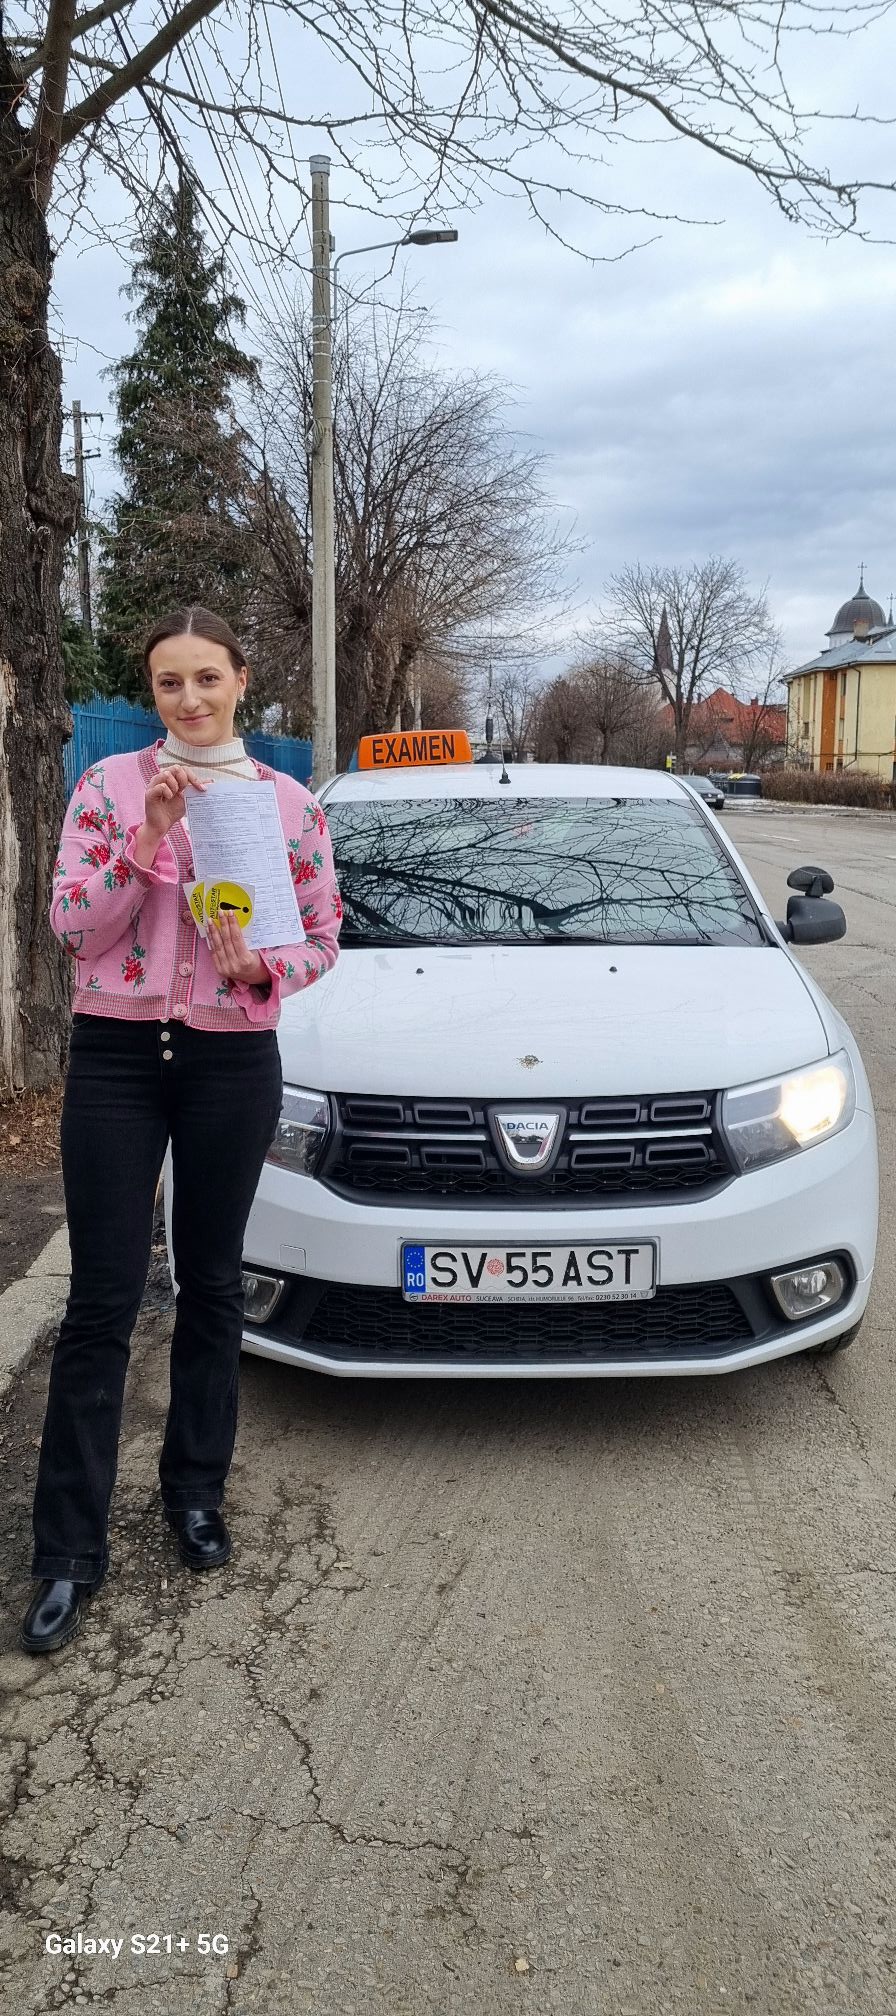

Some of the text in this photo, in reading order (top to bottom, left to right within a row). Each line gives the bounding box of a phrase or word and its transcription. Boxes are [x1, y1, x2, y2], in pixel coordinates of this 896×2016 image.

[372, 734, 455, 764] EXAMEN
[506, 1122, 549, 1130] DACIA
[430, 1248, 640, 1289] SV 55 AST
[407, 1272, 424, 1287] RO
[421, 1294, 449, 1302] DAREX
[449, 1294, 472, 1302] AUTO
